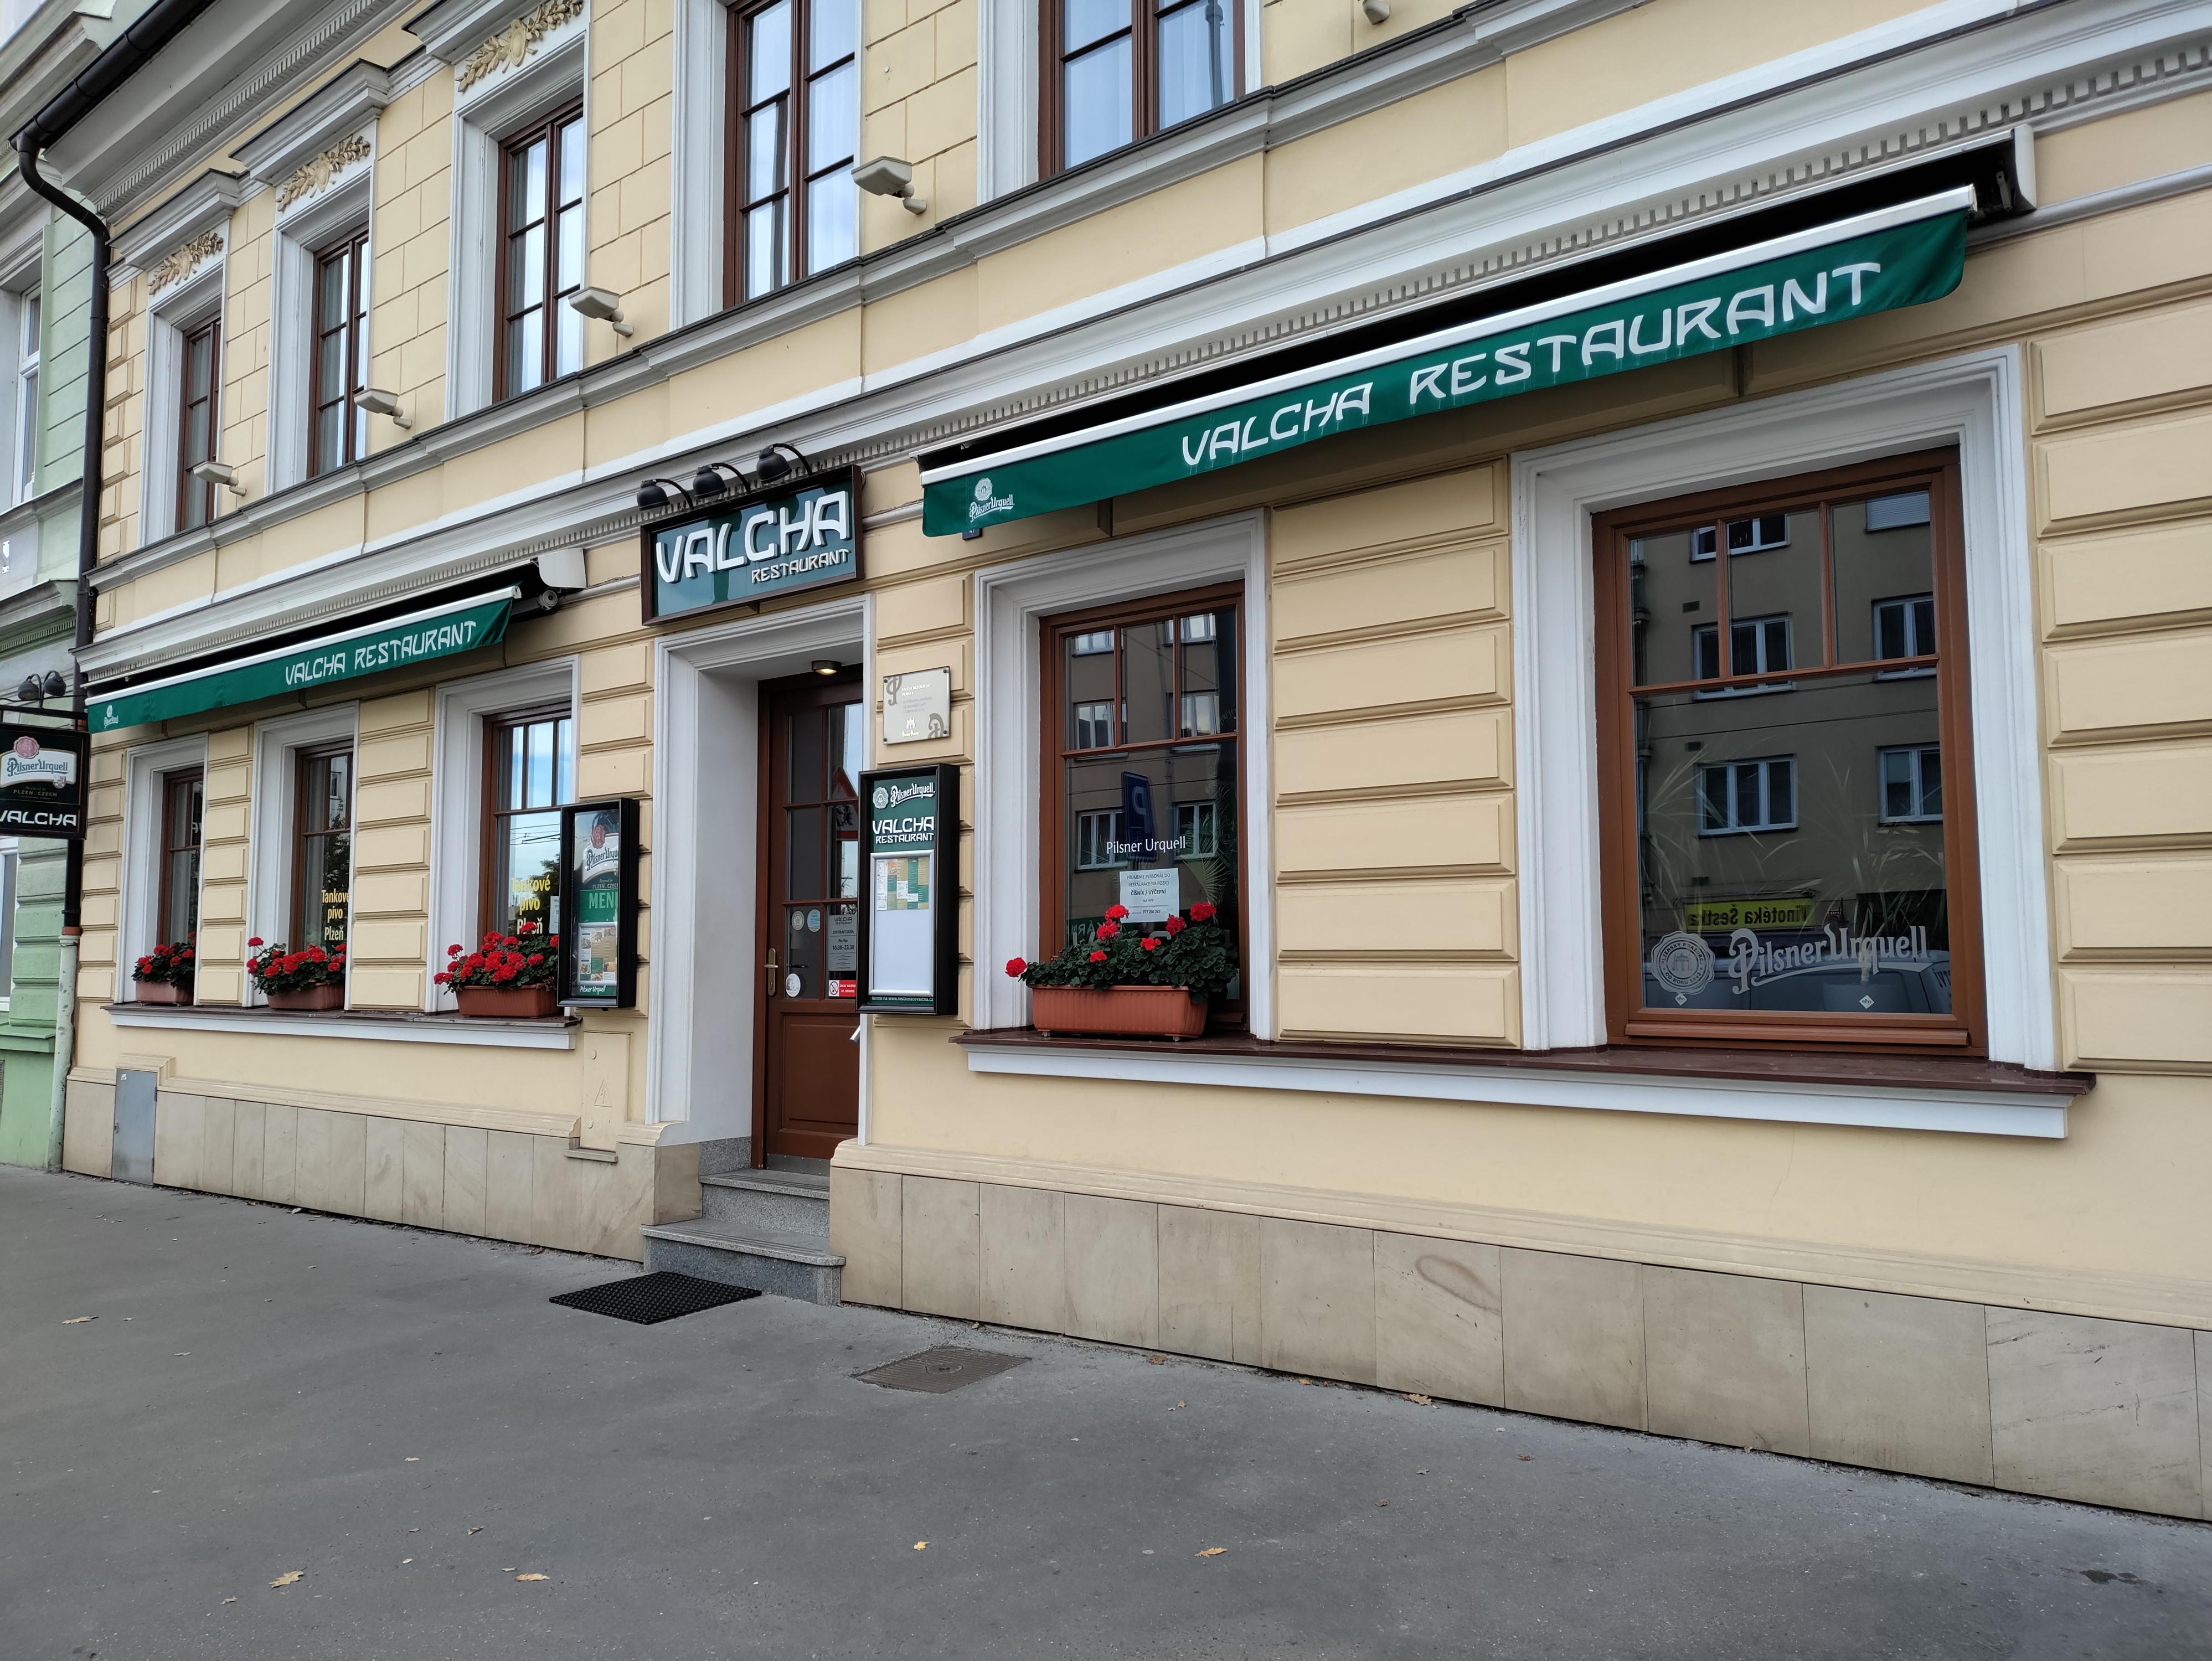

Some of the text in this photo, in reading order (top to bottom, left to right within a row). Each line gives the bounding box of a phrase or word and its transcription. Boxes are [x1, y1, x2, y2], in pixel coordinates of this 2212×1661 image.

[1183, 261, 1881, 466] VALCHA RESTAURANT
[969, 494, 1013, 523] Pilsner Urquell
[656, 491, 850, 583] VALCHA
[751, 548, 850, 583] RESTAURANT
[285, 621, 477, 685] VALCHA RESTAURANT
[7, 757, 68, 777] Pilsner Urquell
[890, 782, 934, 808] Pilsner Urquell
[0, 810, 76, 827] VALCHA
[872, 816, 935, 834] VALCHA
[875, 833, 935, 844] RESTAURANT
[1106, 835, 1186, 854] Pilsner Urquell
[586, 848, 605, 871] Pilsner
[327, 905, 343, 923] pivo
[519, 896, 540, 916] pivo
[324, 925, 344, 941] Plzeň
[1728, 923, 1926, 995] Pilsner Urquell
